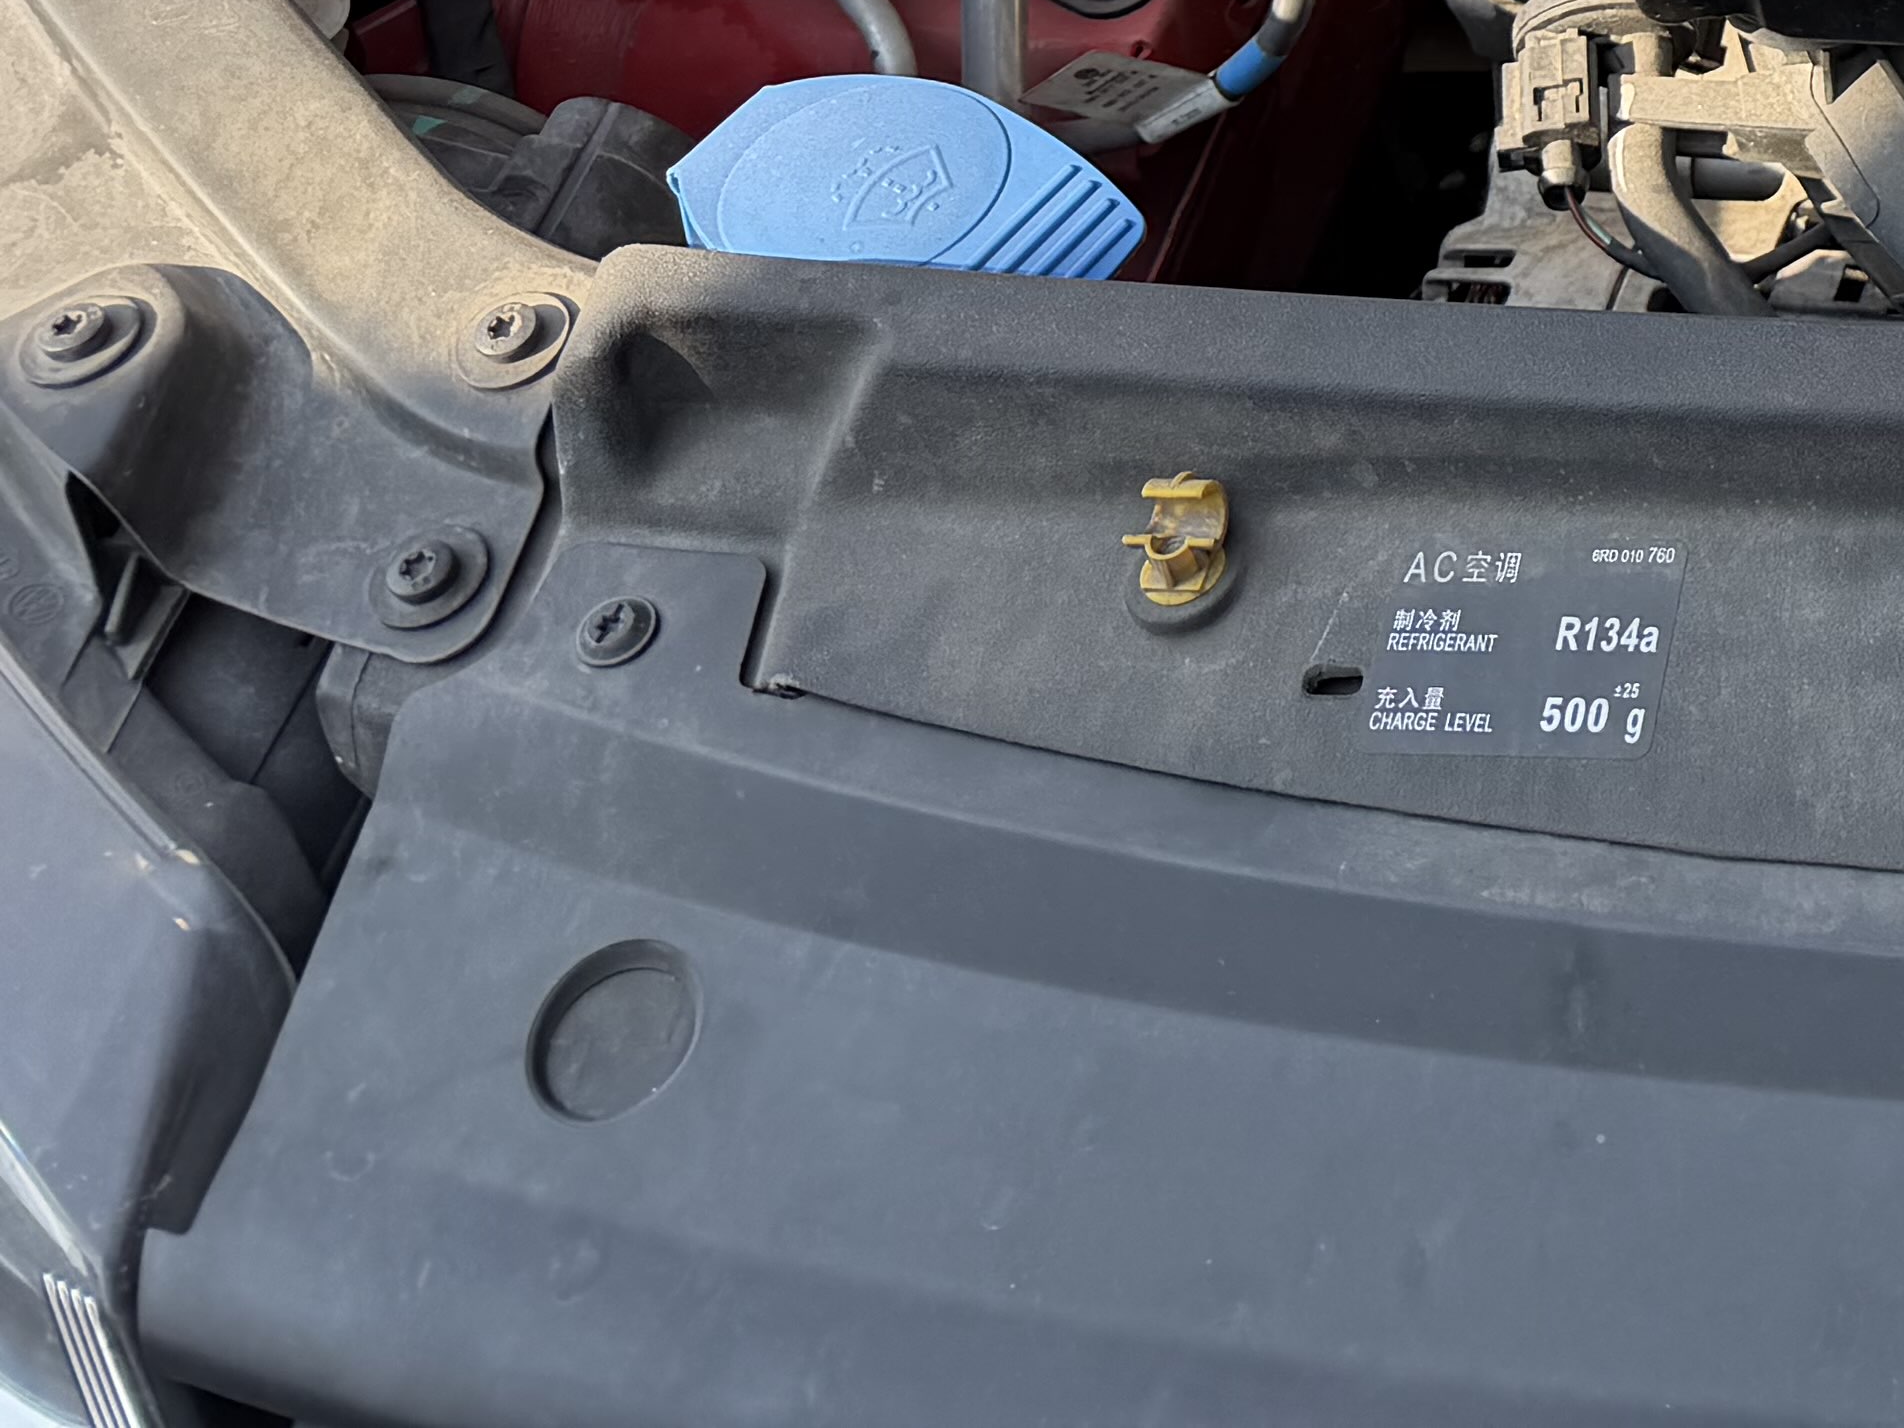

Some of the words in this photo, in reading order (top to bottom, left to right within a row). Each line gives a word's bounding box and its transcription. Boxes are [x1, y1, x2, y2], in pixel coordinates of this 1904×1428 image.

[1620, 548, 1644, 564] 010
[1647, 546, 1676, 564] 760
[1391, 609, 1463, 631] 制冷剂
[1386, 633, 1499, 653] REFRIGERANT
[1555, 616, 1661, 653] R134a
[1374, 686, 1445, 711] 充入量
[1369, 712, 1437, 732] CHARGE
[1444, 713, 1494, 733] LEVEL
[1539, 697, 1609, 733] 500
[1624, 708, 1647, 744] g
